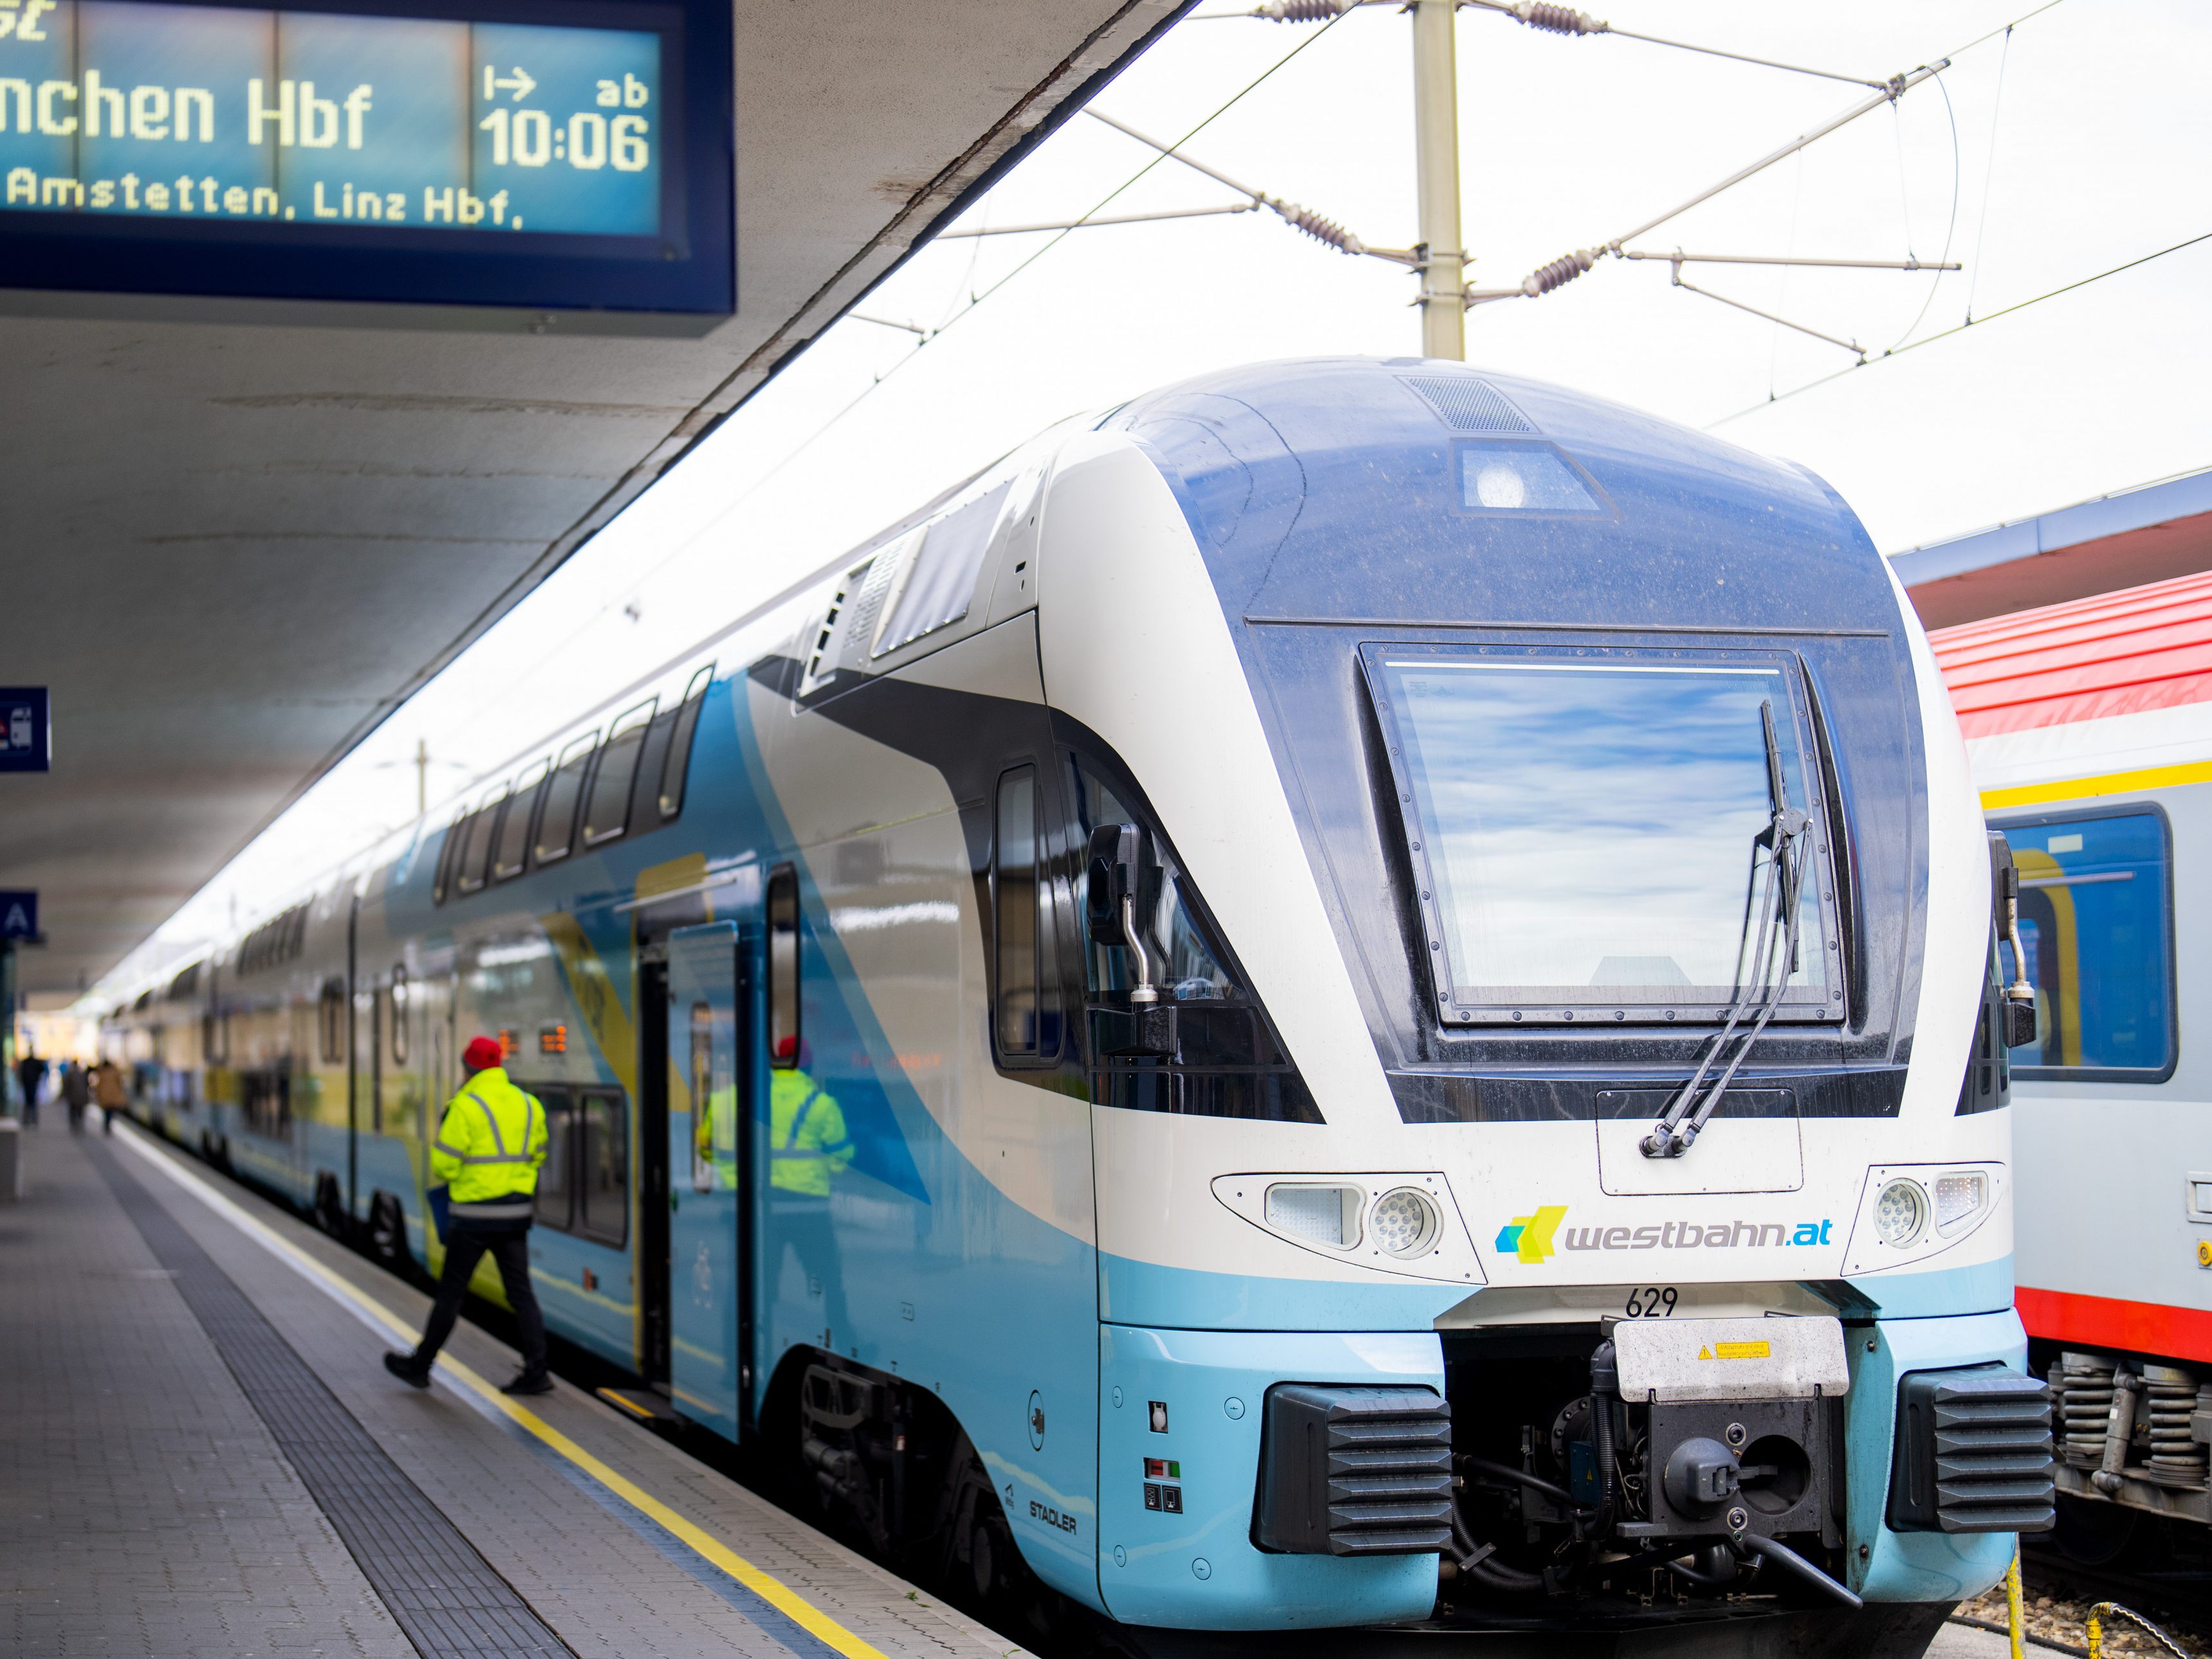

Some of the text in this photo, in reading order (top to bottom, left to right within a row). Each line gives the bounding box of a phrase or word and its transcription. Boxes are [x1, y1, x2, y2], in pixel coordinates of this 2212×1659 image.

[596, 72, 649, 108] ab
[248, 78, 373, 150] Hbf
[479, 108, 649, 172] 10:06
[314, 181, 405, 221] Linz
[424, 186, 523, 230] Hbf,
[5, 903, 28, 931] A
[1565, 1219, 1833, 1251] westbahn.at
[1626, 1287, 1678, 1317] 629
[1029, 1500, 1076, 1535] STADLER
